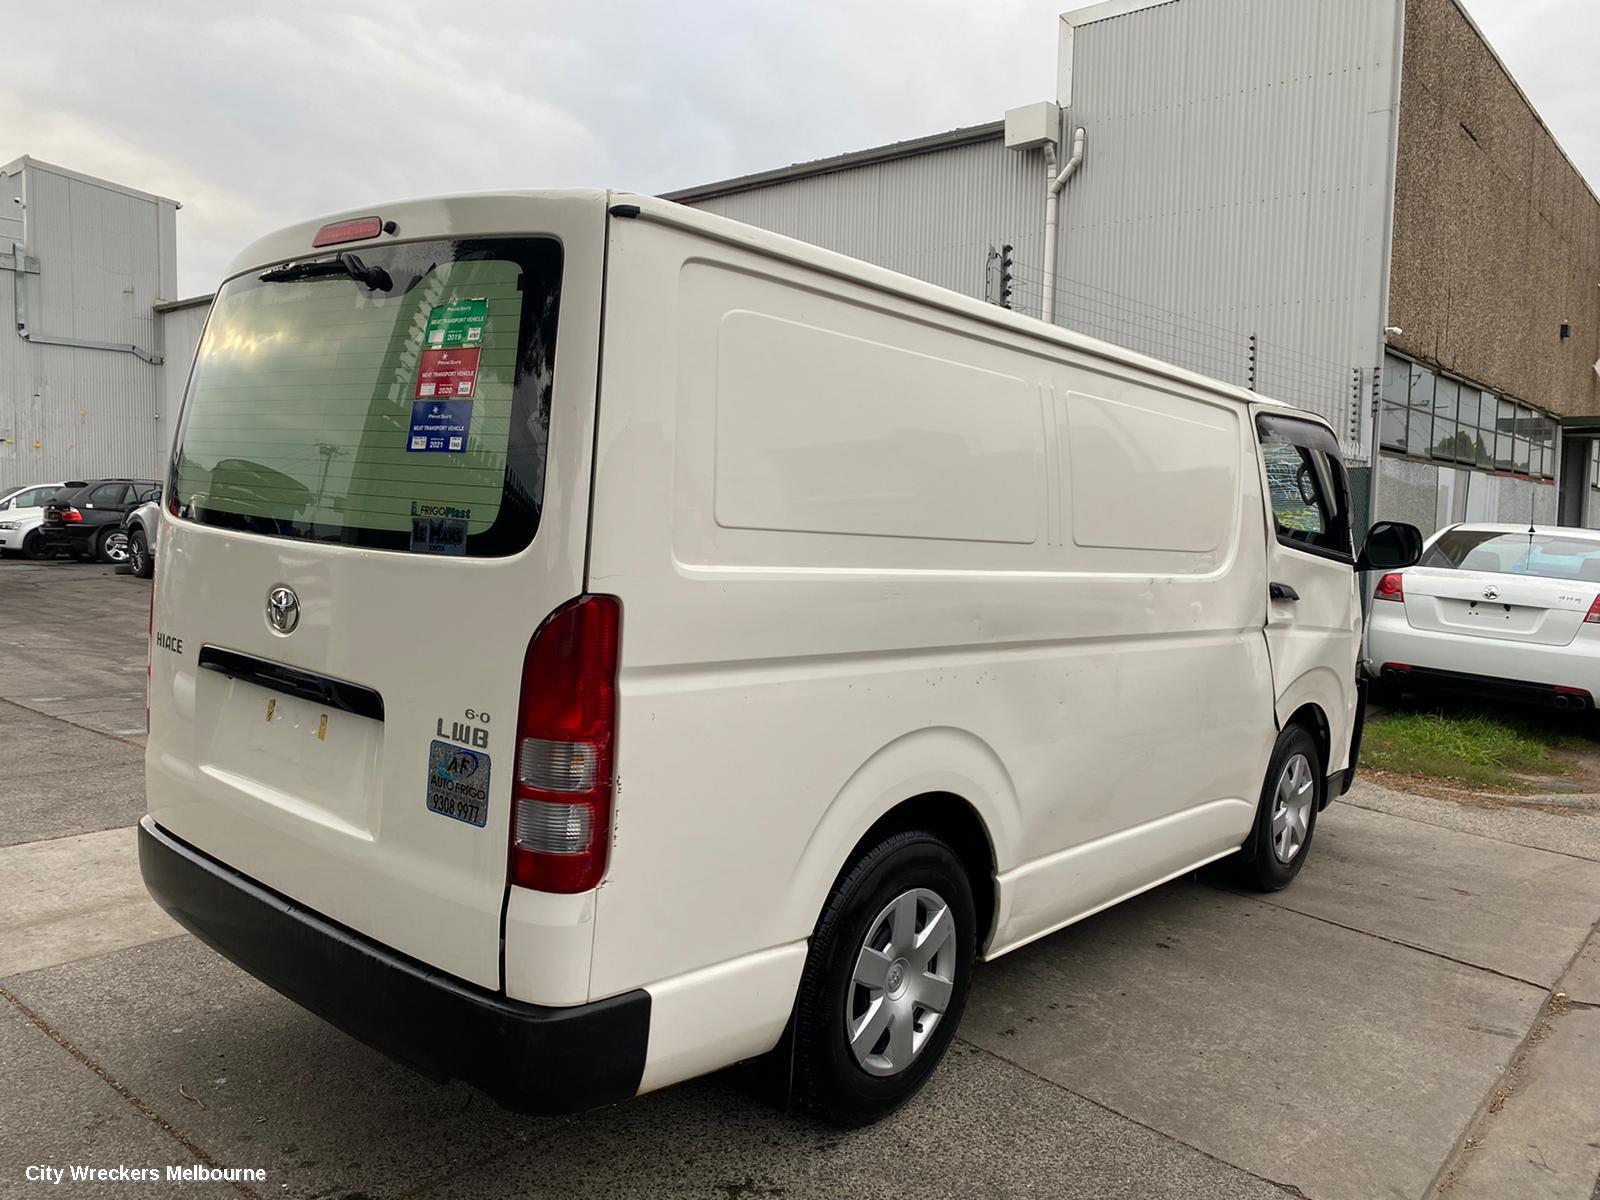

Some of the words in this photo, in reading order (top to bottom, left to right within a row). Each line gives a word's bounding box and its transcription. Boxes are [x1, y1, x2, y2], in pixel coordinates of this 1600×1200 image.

[156, 631, 183, 654] HIACE
[436, 717, 489, 749] LWB
[446, 756, 470, 774] AF
[431, 774, 455, 791] AUTO
[455, 782, 486, 800] FRIGO
[432, 793, 455, 815] 9308
